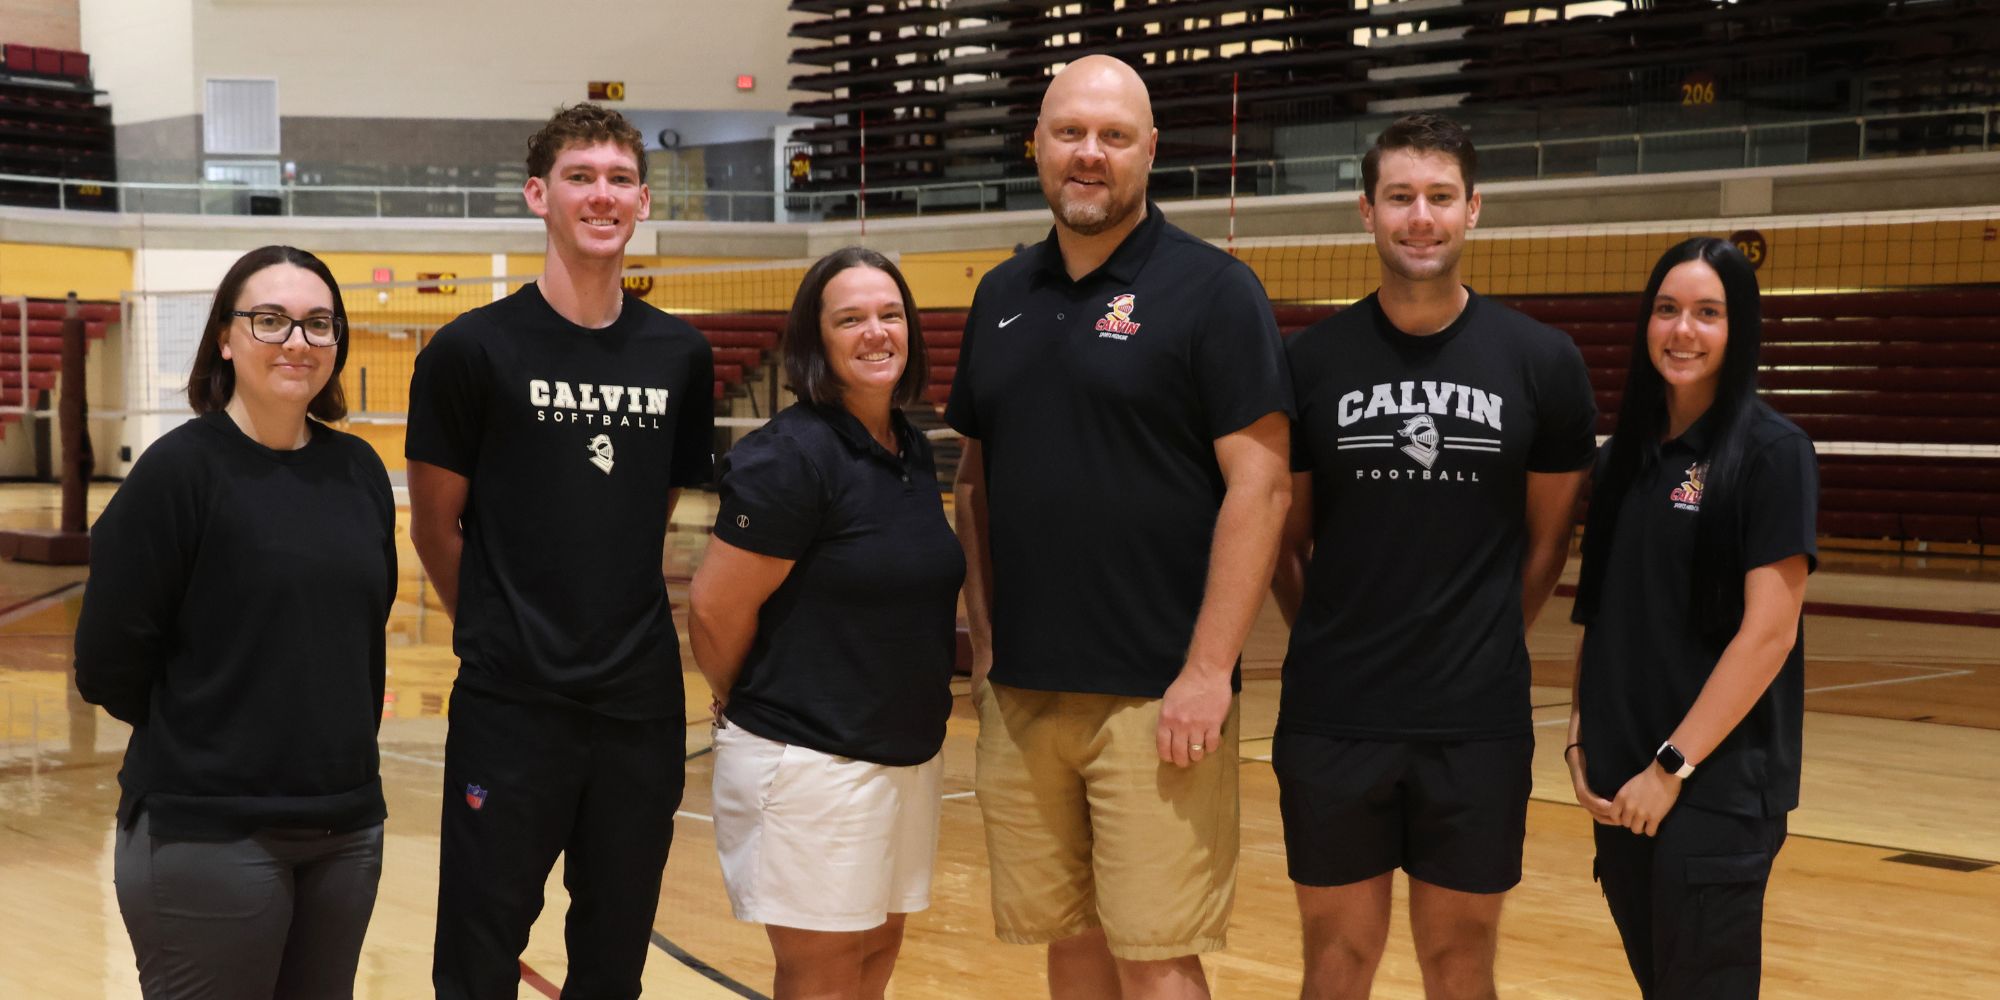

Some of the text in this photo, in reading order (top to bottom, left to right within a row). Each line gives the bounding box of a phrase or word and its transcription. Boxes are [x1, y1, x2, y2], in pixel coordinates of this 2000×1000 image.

[1682, 82, 1714, 106] 206
[791, 158, 810, 177] 204
[1736, 240, 1761, 263] 05
[624, 274, 649, 290] 103
[1094, 318, 1141, 335] CALVIN
[529, 379, 669, 415] CALVIN
[1337, 381, 1503, 431] CALVIN
[537, 410, 659, 429] SOFTBALL
[1356, 469, 1479, 482] FOOTBALL
